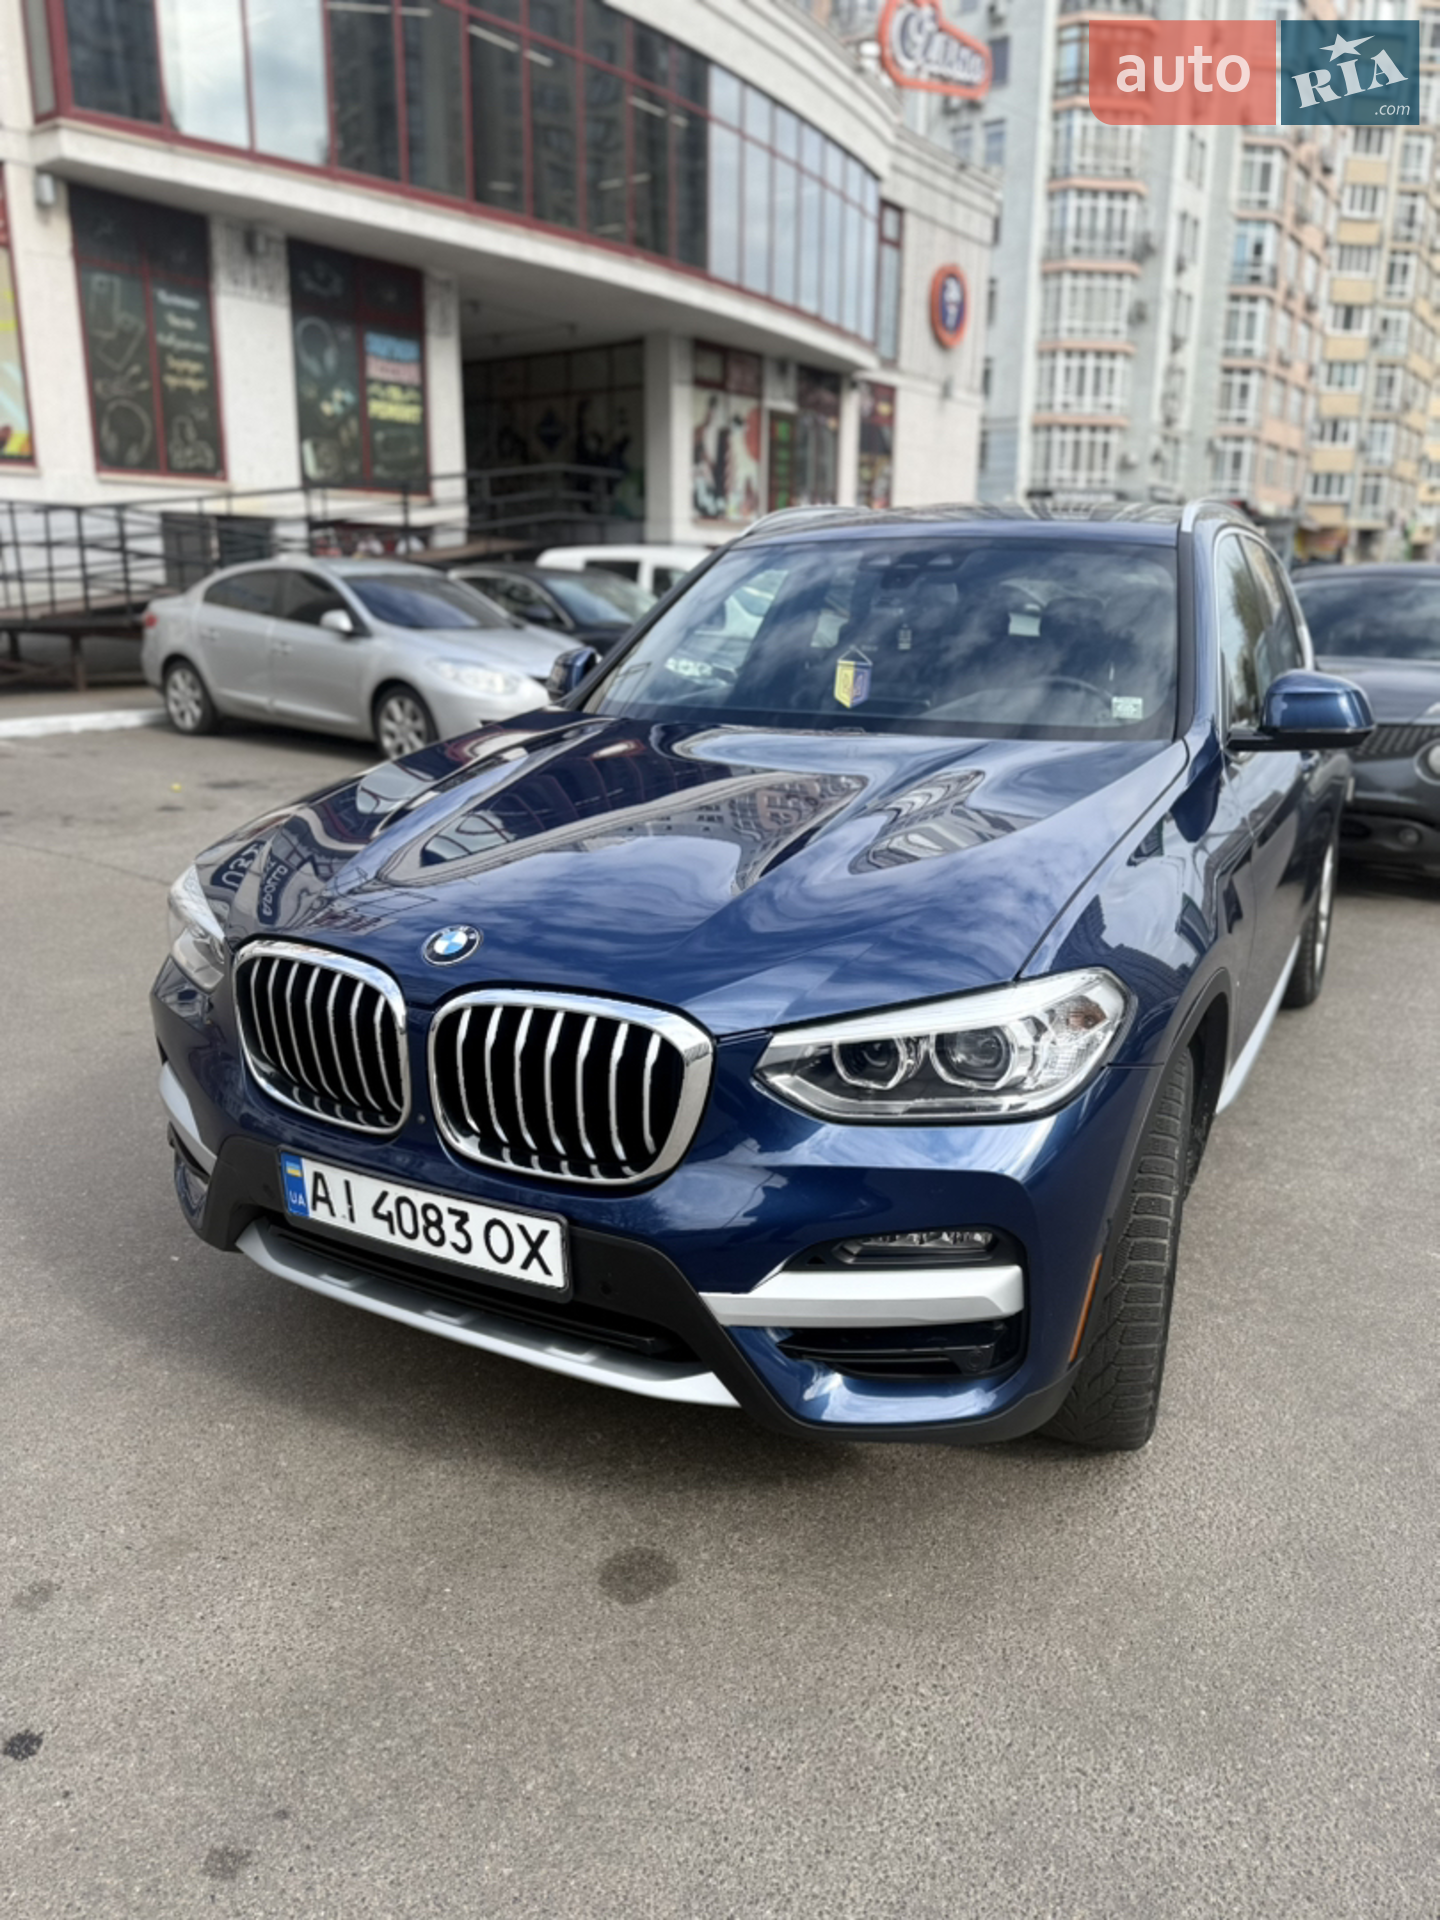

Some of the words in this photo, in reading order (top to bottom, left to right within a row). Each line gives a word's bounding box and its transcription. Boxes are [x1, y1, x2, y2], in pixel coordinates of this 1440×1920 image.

[289, 1190, 306, 1207] UA
[311, 1171, 356, 1223] AI
[372, 1190, 472, 1254] 4083
[483, 1218, 553, 1277] OX
